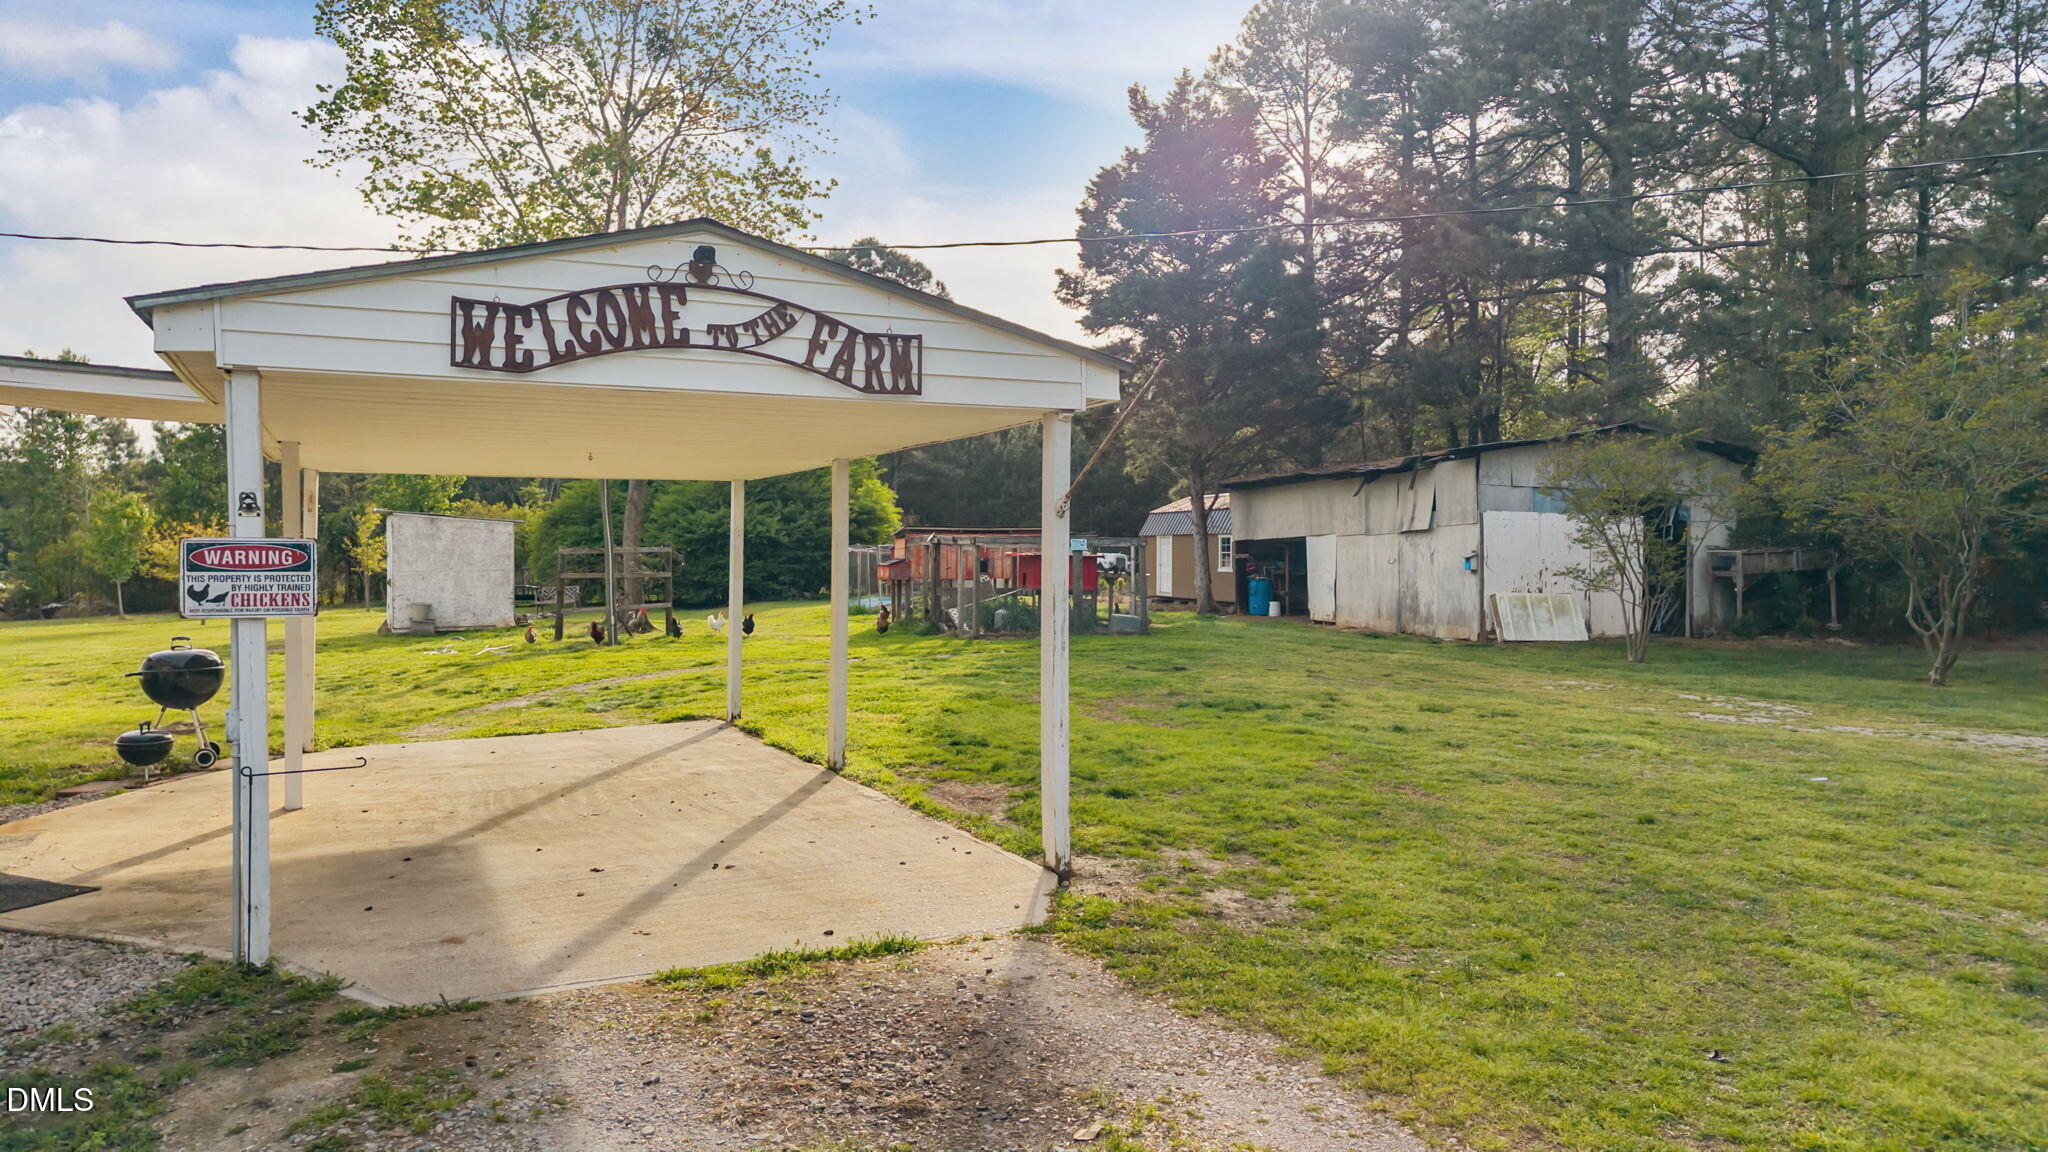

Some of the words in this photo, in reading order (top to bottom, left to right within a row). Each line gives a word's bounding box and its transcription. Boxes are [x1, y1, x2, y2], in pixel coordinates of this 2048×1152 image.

[458, 286, 690, 368] WELCOME
[707, 323, 739, 348] TO
[743, 303, 798, 345] THE
[802, 314, 916, 392] FARM
[204, 550, 293, 565] WARNING
[186, 575, 205, 583] THIS
[208, 575, 251, 583] PROPERTY
[254, 575, 261, 583] IS
[264, 575, 311, 583] PROTECTED
[231, 584, 242, 592] BY
[245, 584, 274, 592] HIGHLY
[277, 584, 311, 592] TRAINED
[231, 593, 310, 607] CHICKENS
